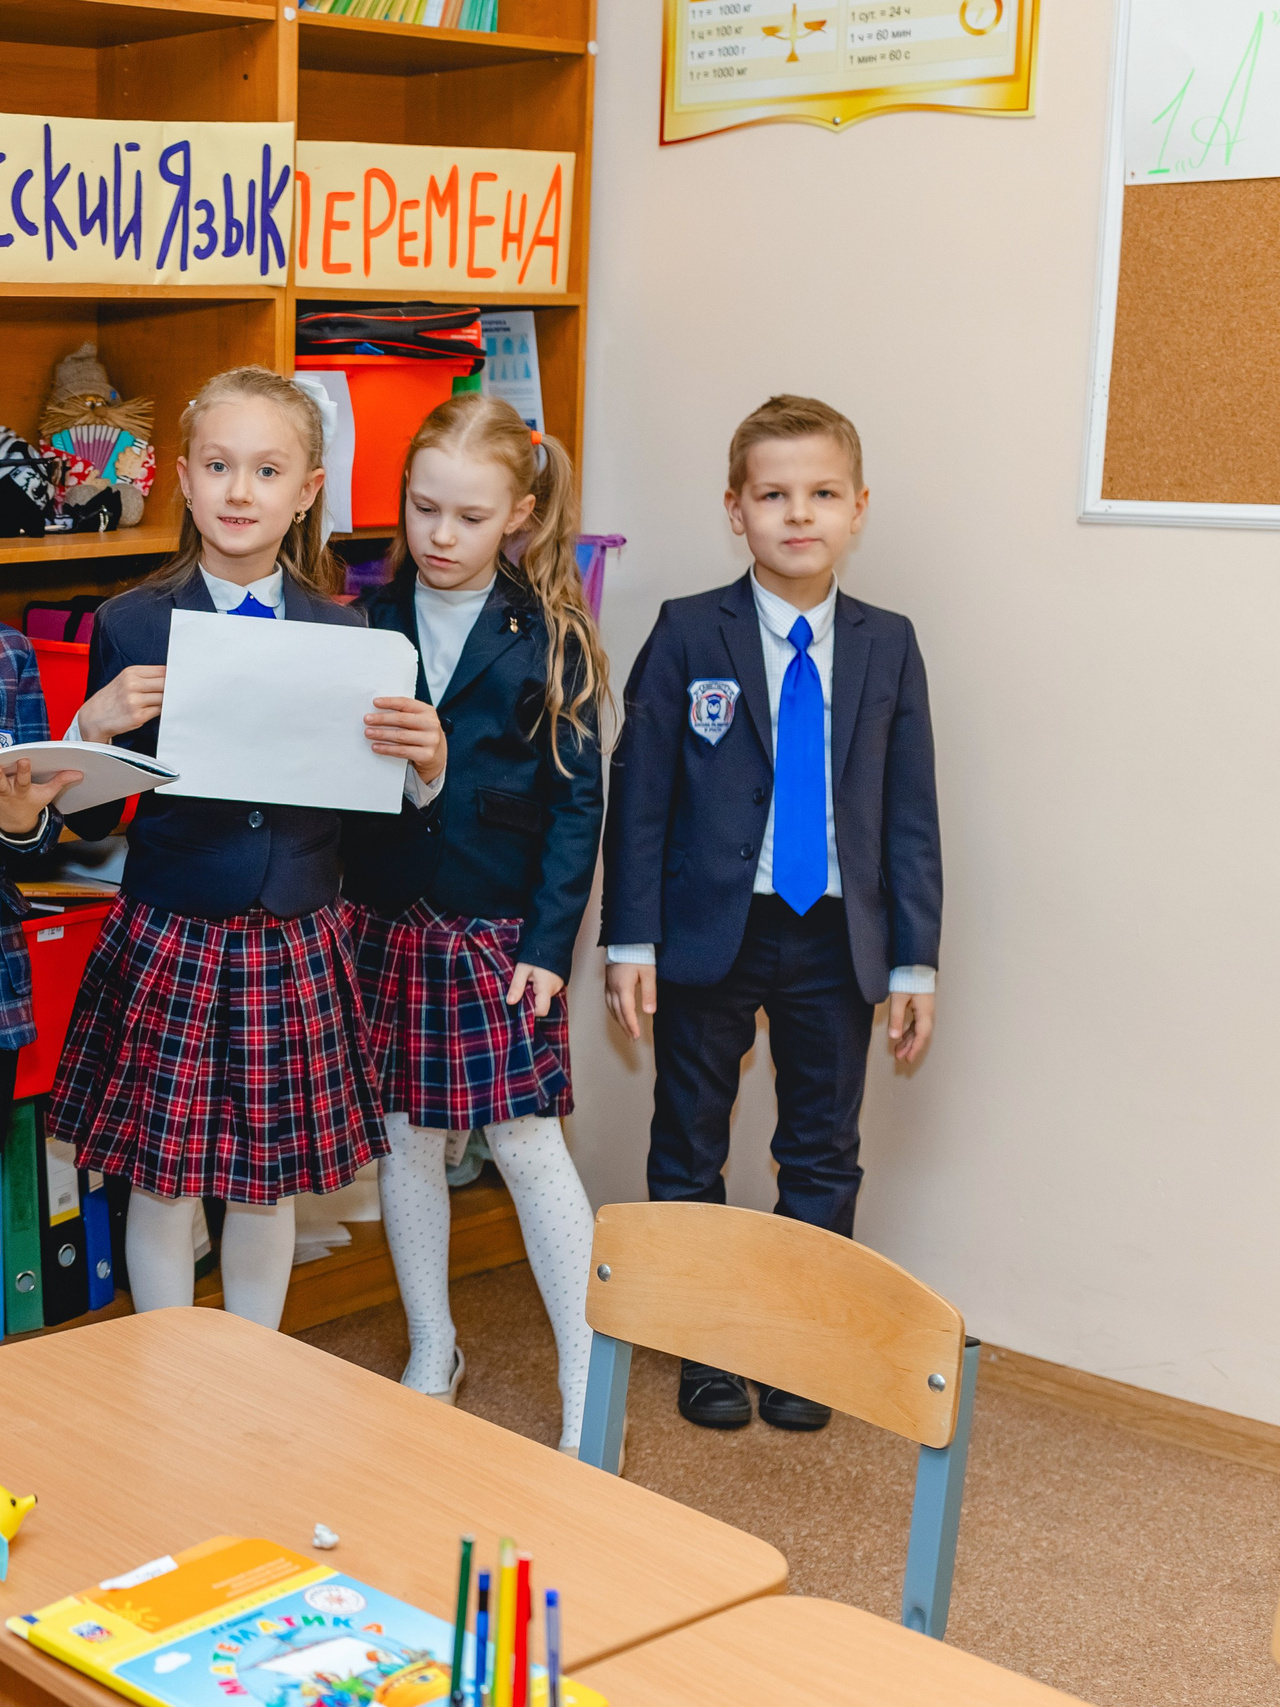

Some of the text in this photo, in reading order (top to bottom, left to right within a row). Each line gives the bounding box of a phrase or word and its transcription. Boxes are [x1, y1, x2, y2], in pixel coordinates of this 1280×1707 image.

[720, 4, 741, 16] 1000
[889, 6, 901, 18] 24
[716, 26, 732, 36] 100
[876, 29, 889, 41] 60
[892, 30, 912, 39] мин
[718, 46, 739, 57] 1000
[857, 55, 877, 64] мин
[889, 50, 902, 61] 60
[712, 67, 734, 78] 1000
